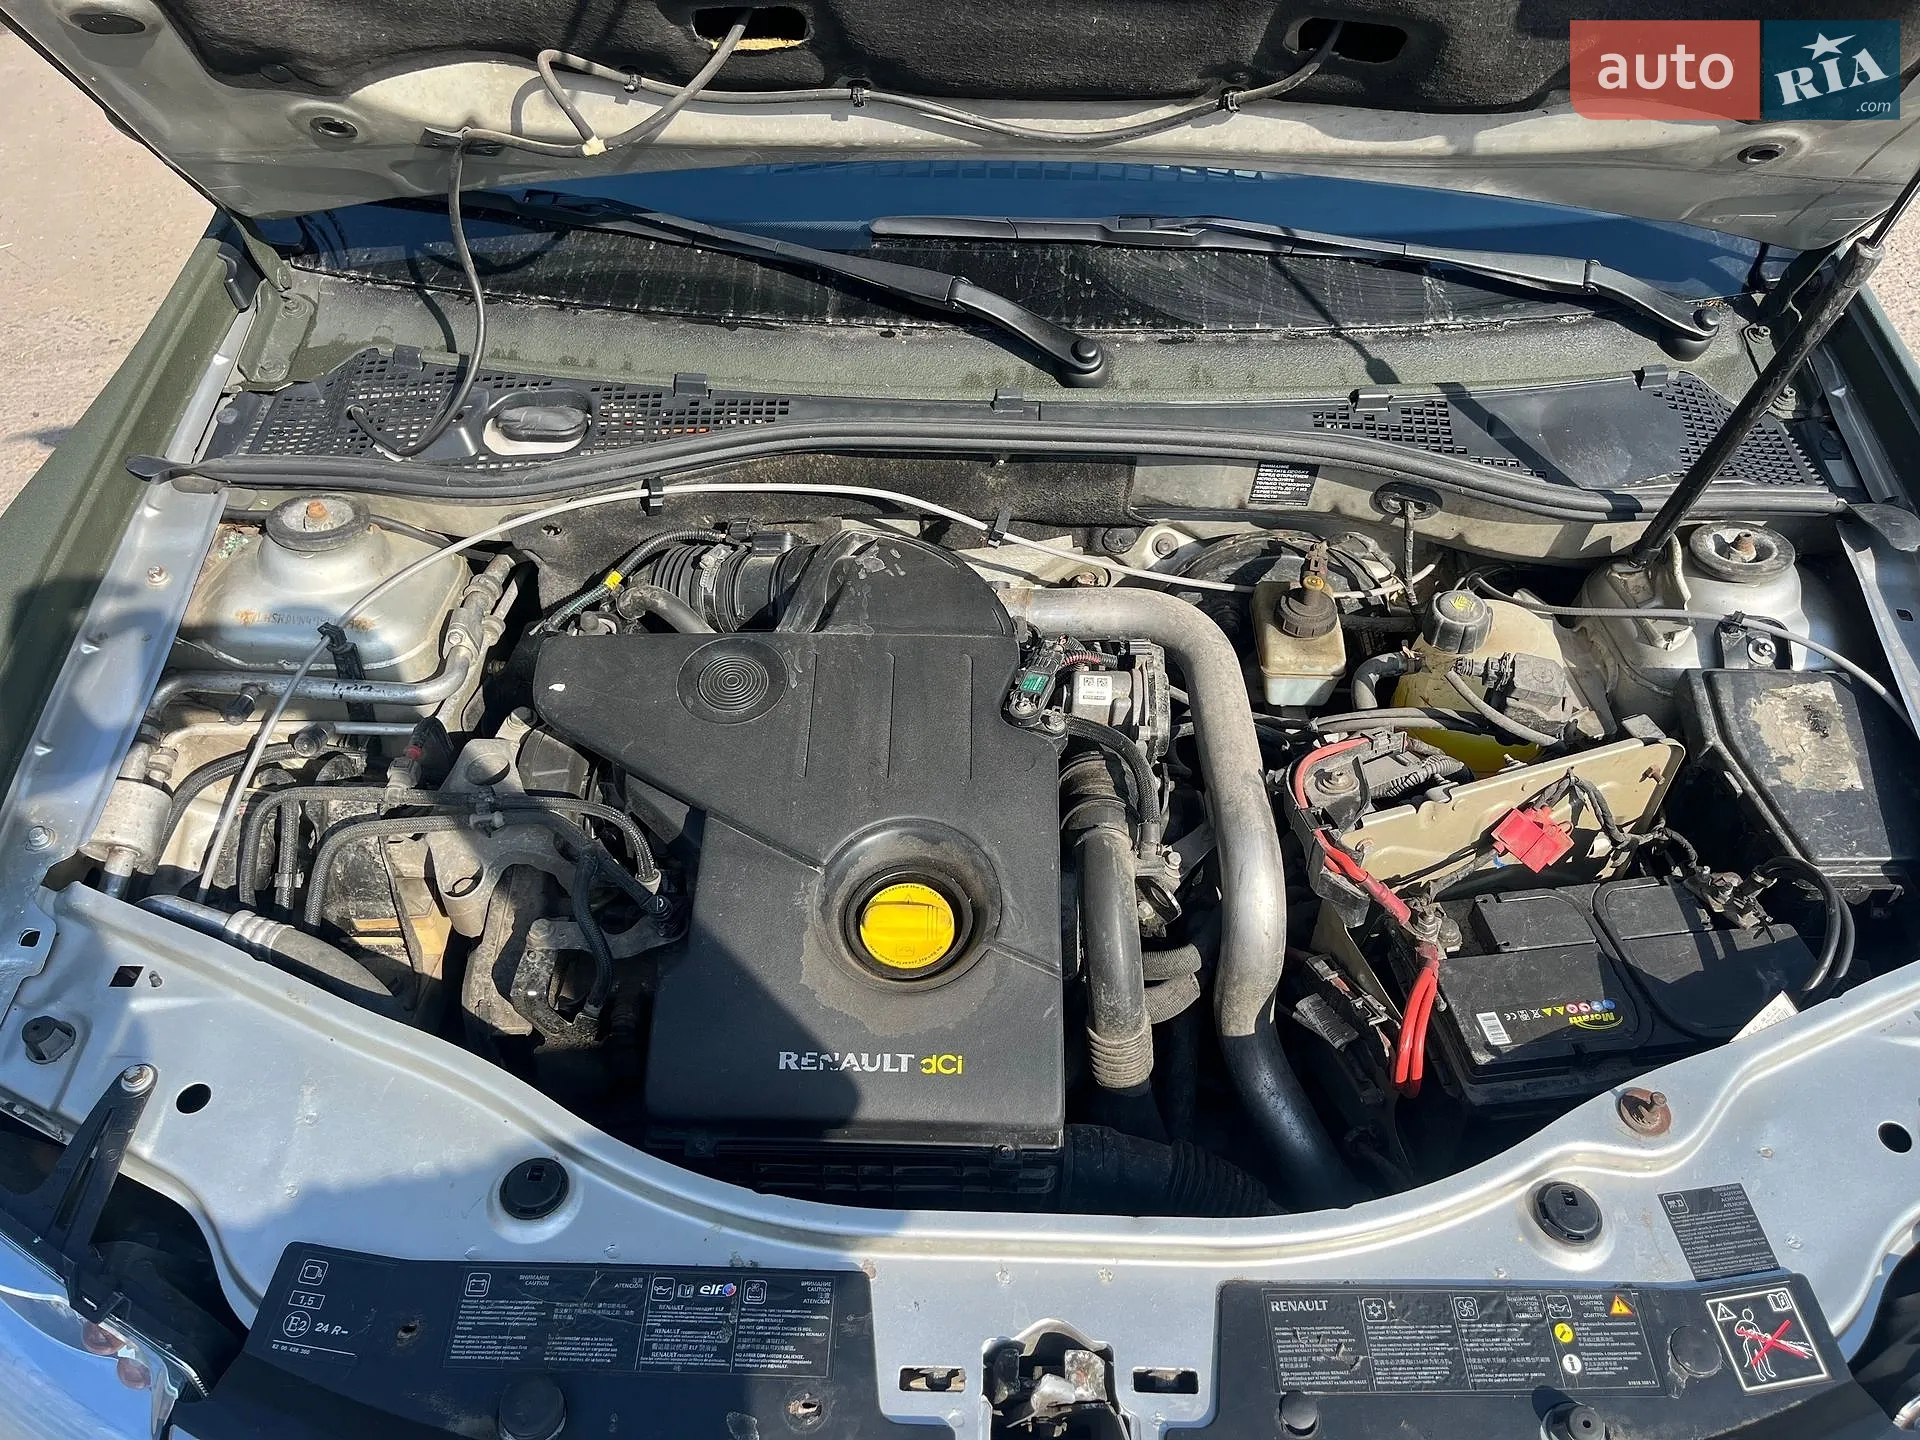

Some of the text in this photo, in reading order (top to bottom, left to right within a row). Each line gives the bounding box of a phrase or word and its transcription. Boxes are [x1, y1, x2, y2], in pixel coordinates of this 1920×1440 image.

[779, 1052, 915, 1073] RENAULT
[700, 1284, 723, 1295] elf
[300, 1295, 315, 1306] 1,5
[1271, 1300, 1328, 1311] RENAULT
[286, 1316, 307, 1331] E2
[315, 1322, 329, 1333] 24
